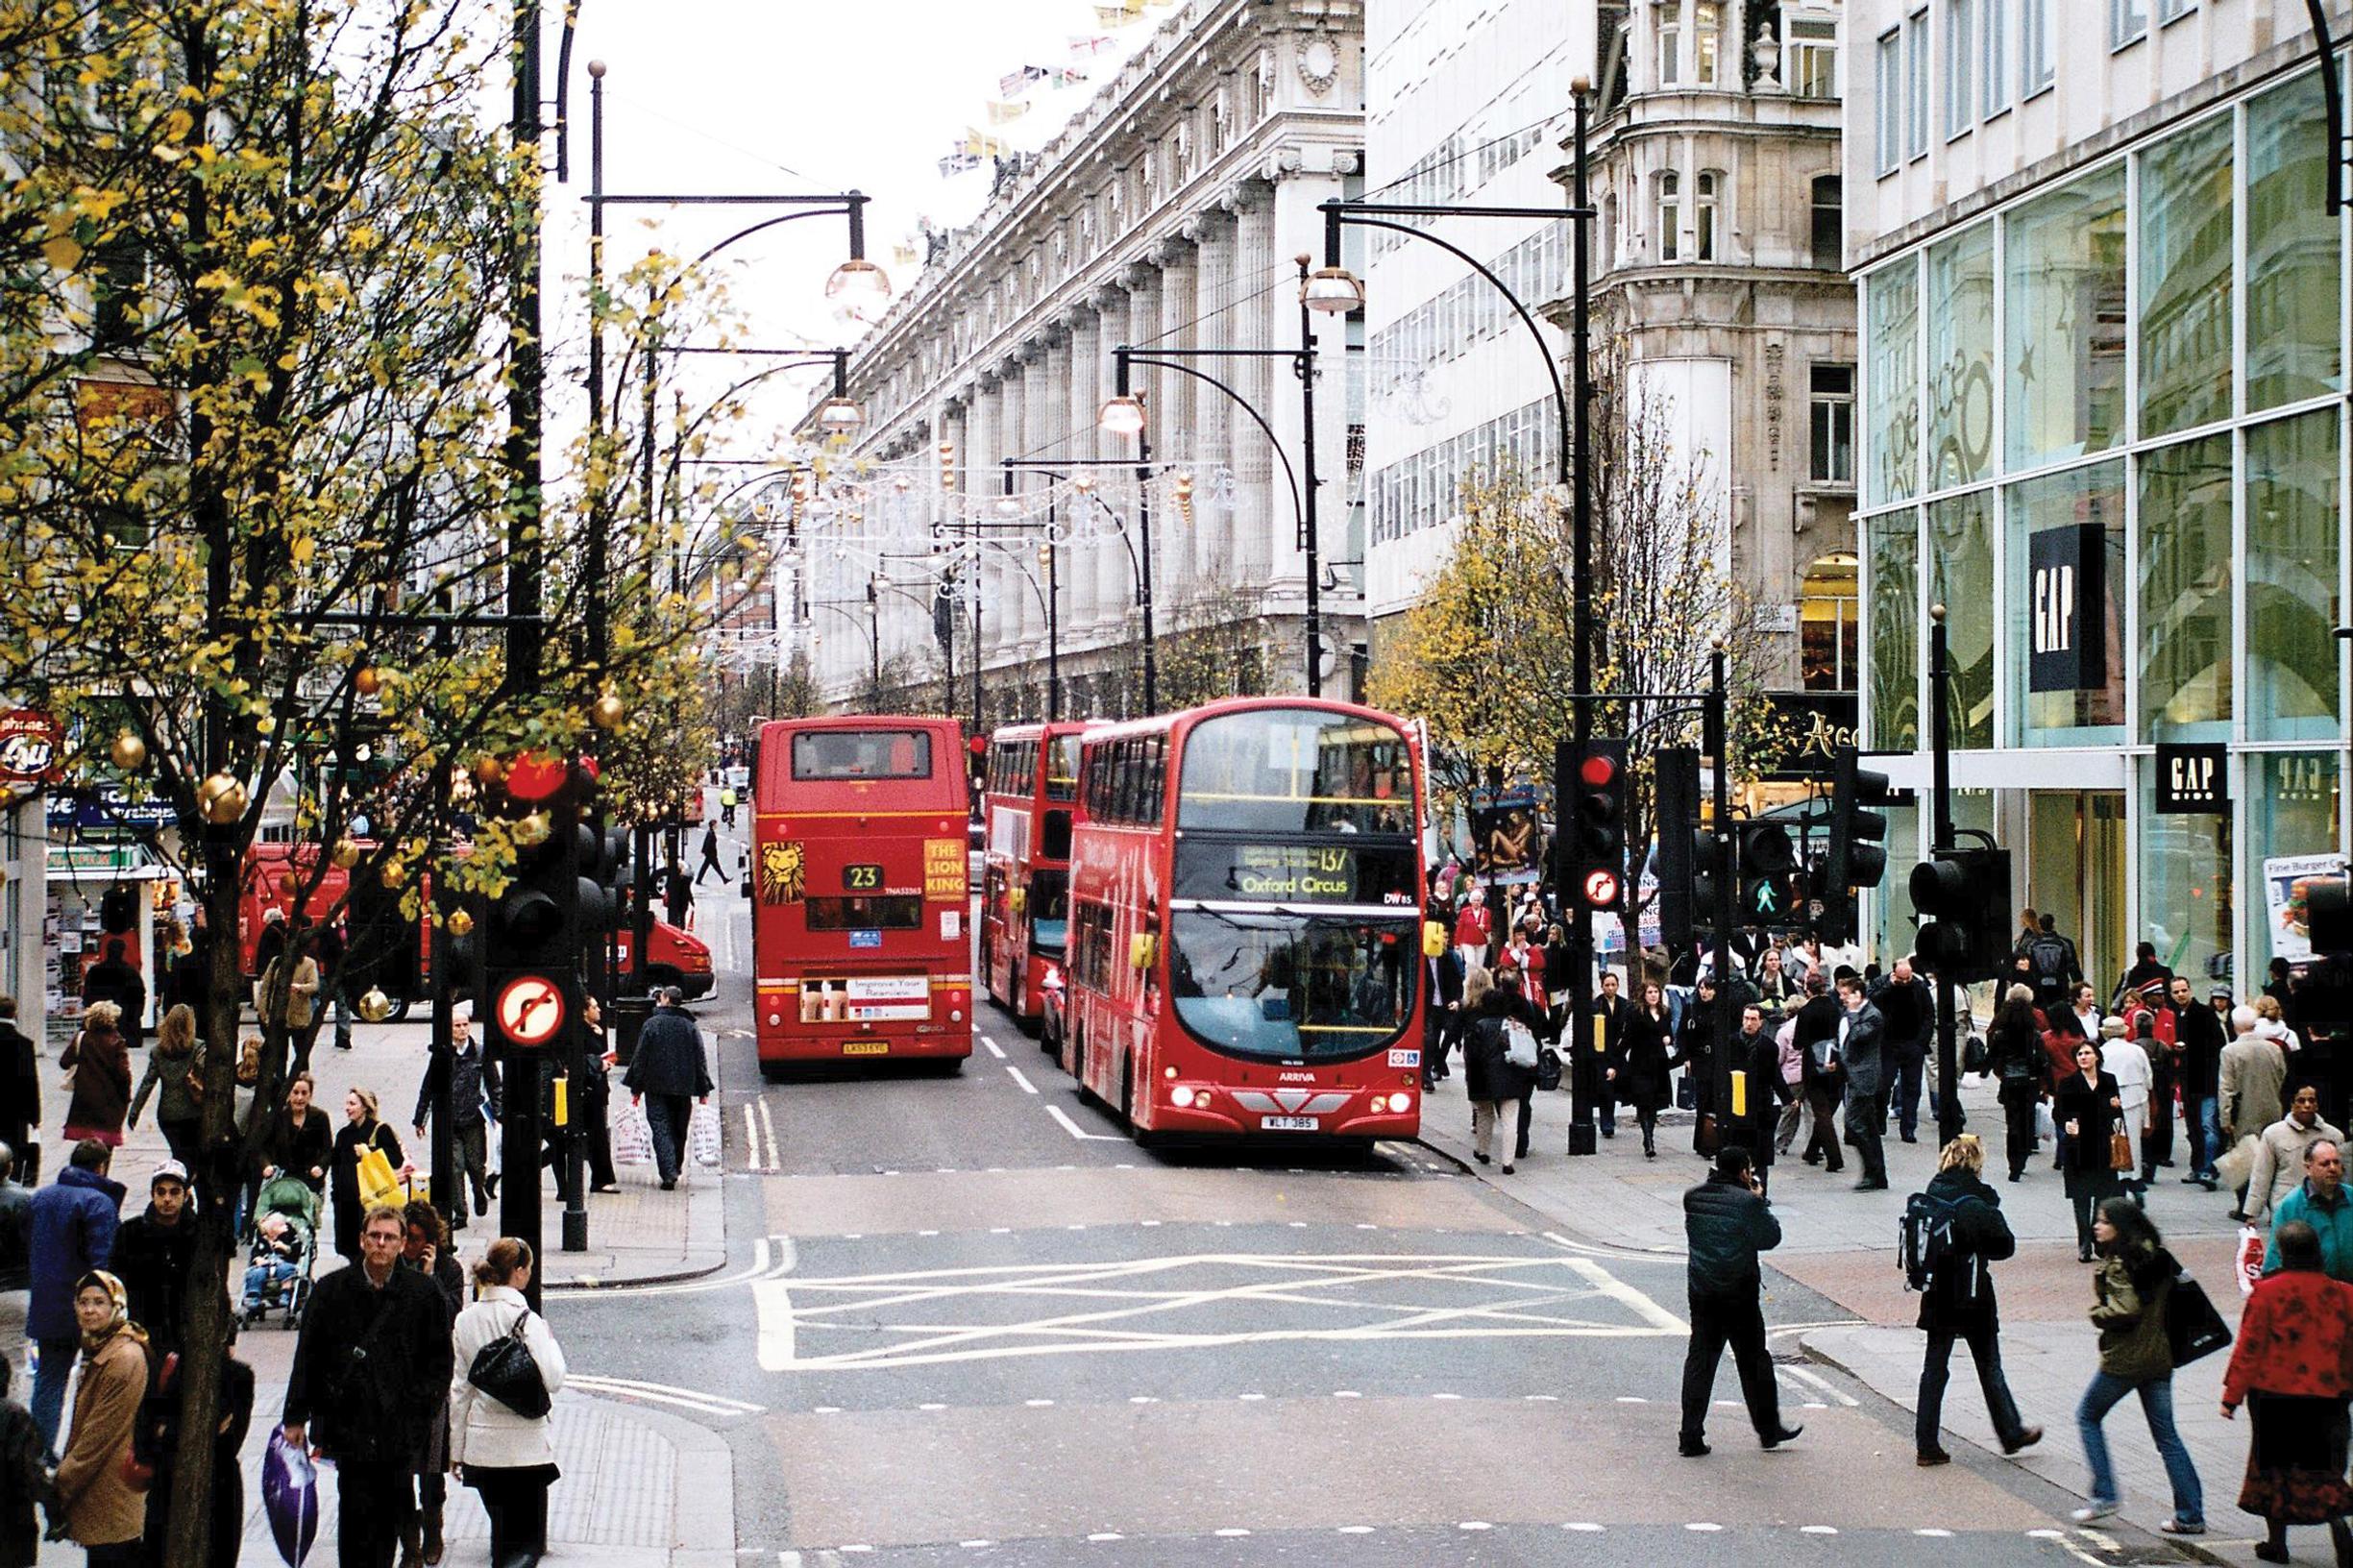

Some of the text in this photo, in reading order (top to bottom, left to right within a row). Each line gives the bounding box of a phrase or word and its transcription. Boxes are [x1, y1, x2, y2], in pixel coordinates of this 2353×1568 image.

[2035, 565, 2072, 654] GAP
[2171, 757, 2214, 790] GAP
[931, 845, 958, 857] THE
[1321, 847, 1349, 871] 137
[926, 861, 963, 874] LION
[850, 867, 876, 887] 23
[926, 877, 965, 891] KING
[1242, 876, 1348, 893] Oxford Circus
[1384, 893, 1401, 904] DW
[1279, 1072, 1315, 1083] ARRIVA
[1269, 1117, 1311, 1129] WLT 385
